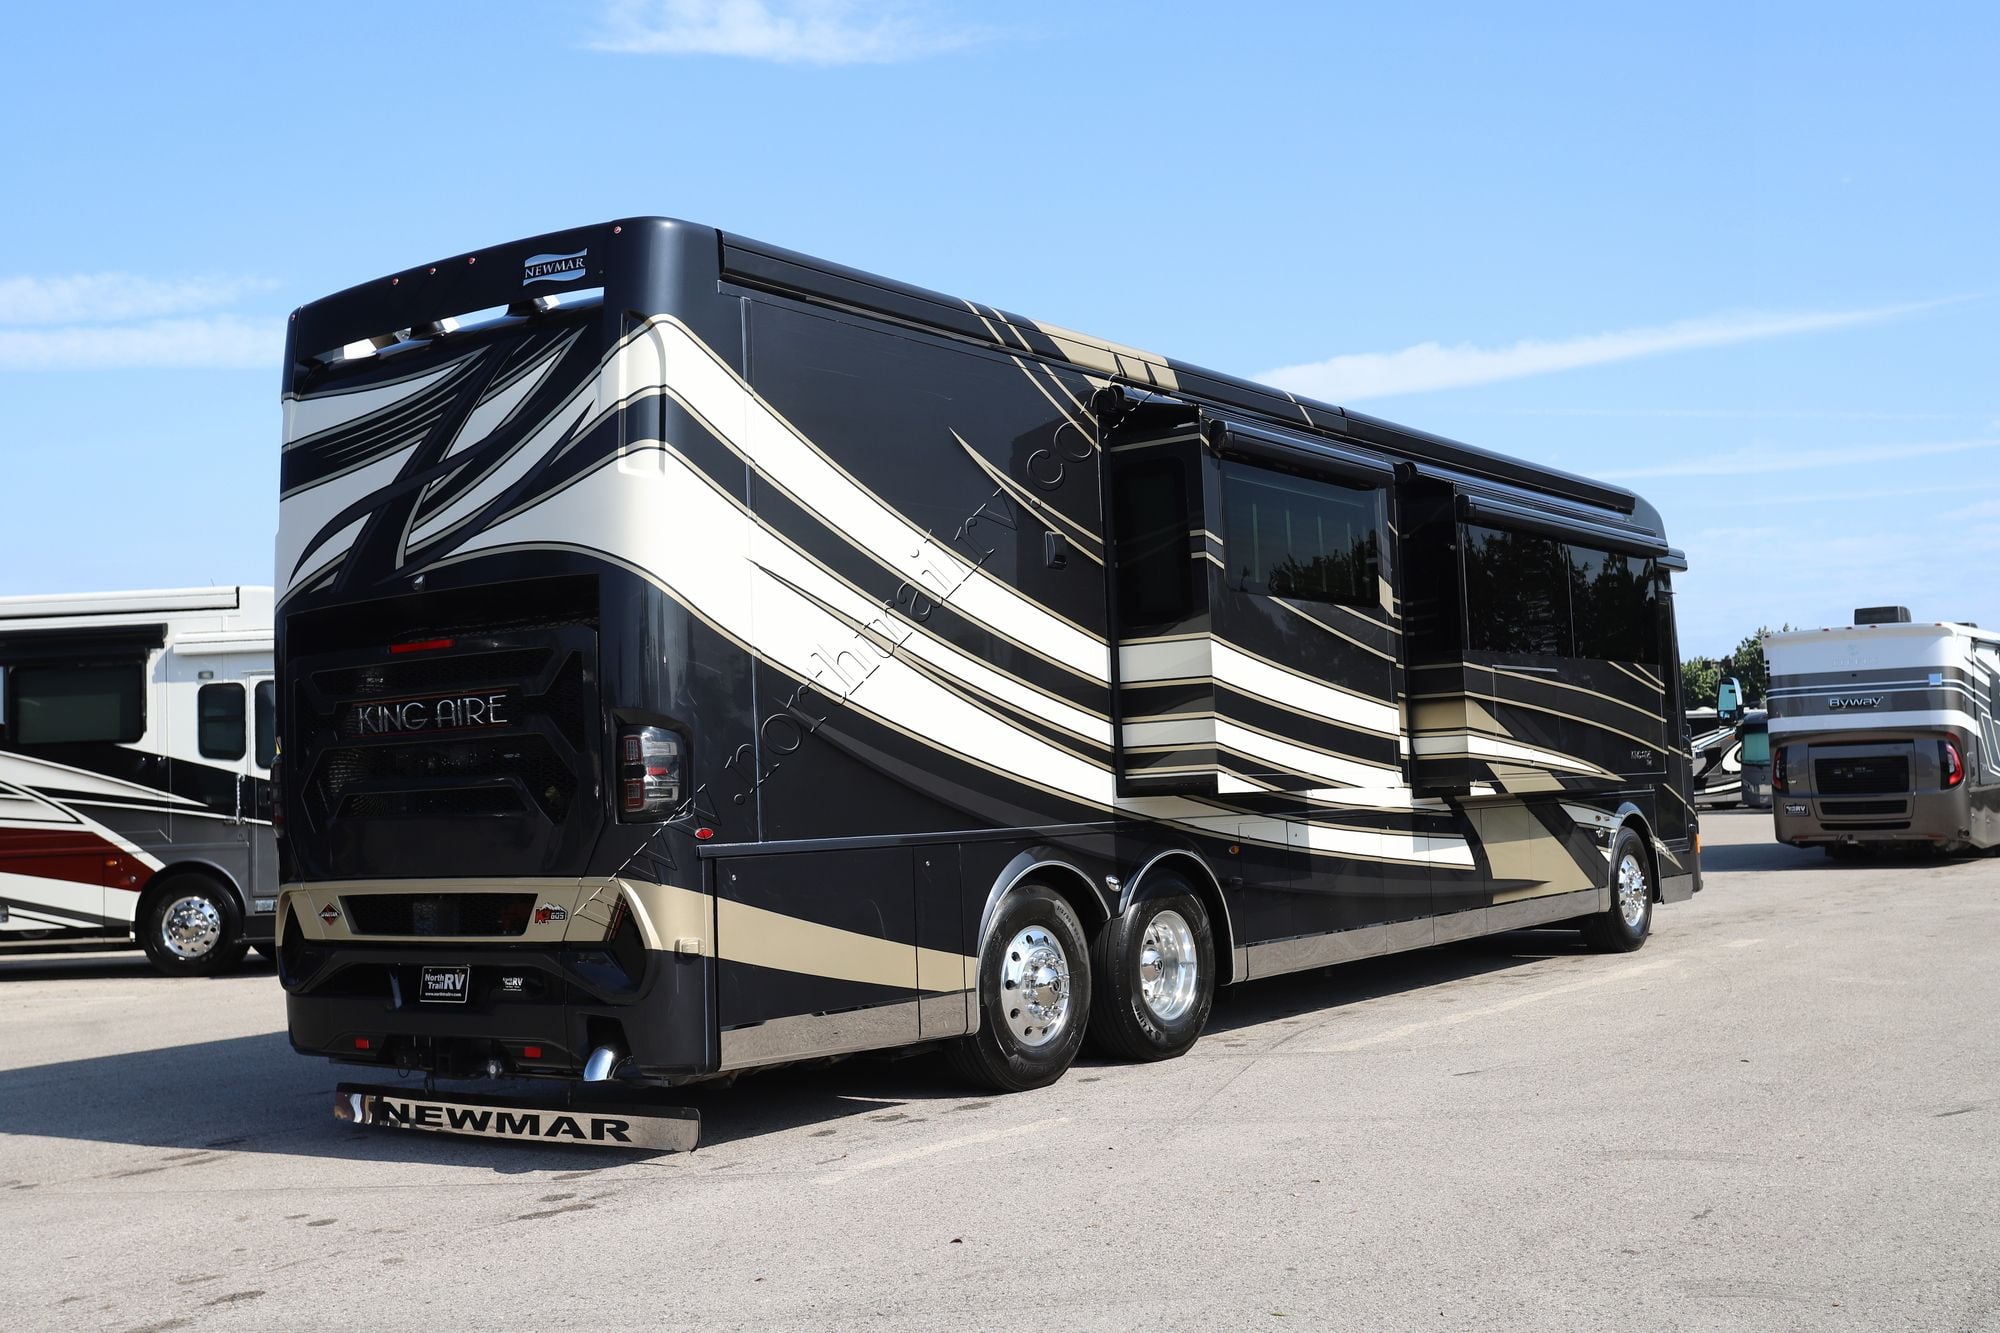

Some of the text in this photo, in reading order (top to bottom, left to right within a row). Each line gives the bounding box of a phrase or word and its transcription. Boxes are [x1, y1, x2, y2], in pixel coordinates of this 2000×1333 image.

[525, 258, 585, 278] NEWMAR
[1829, 697, 1881, 708] Byway
[359, 694, 508, 734] KING AIRE
[551, 912, 565, 920] 605
[425, 973, 445, 981] North
[443, 973, 465, 990] RV
[428, 981, 444, 990] Trail
[383, 1101, 632, 1142] NEWMAR
